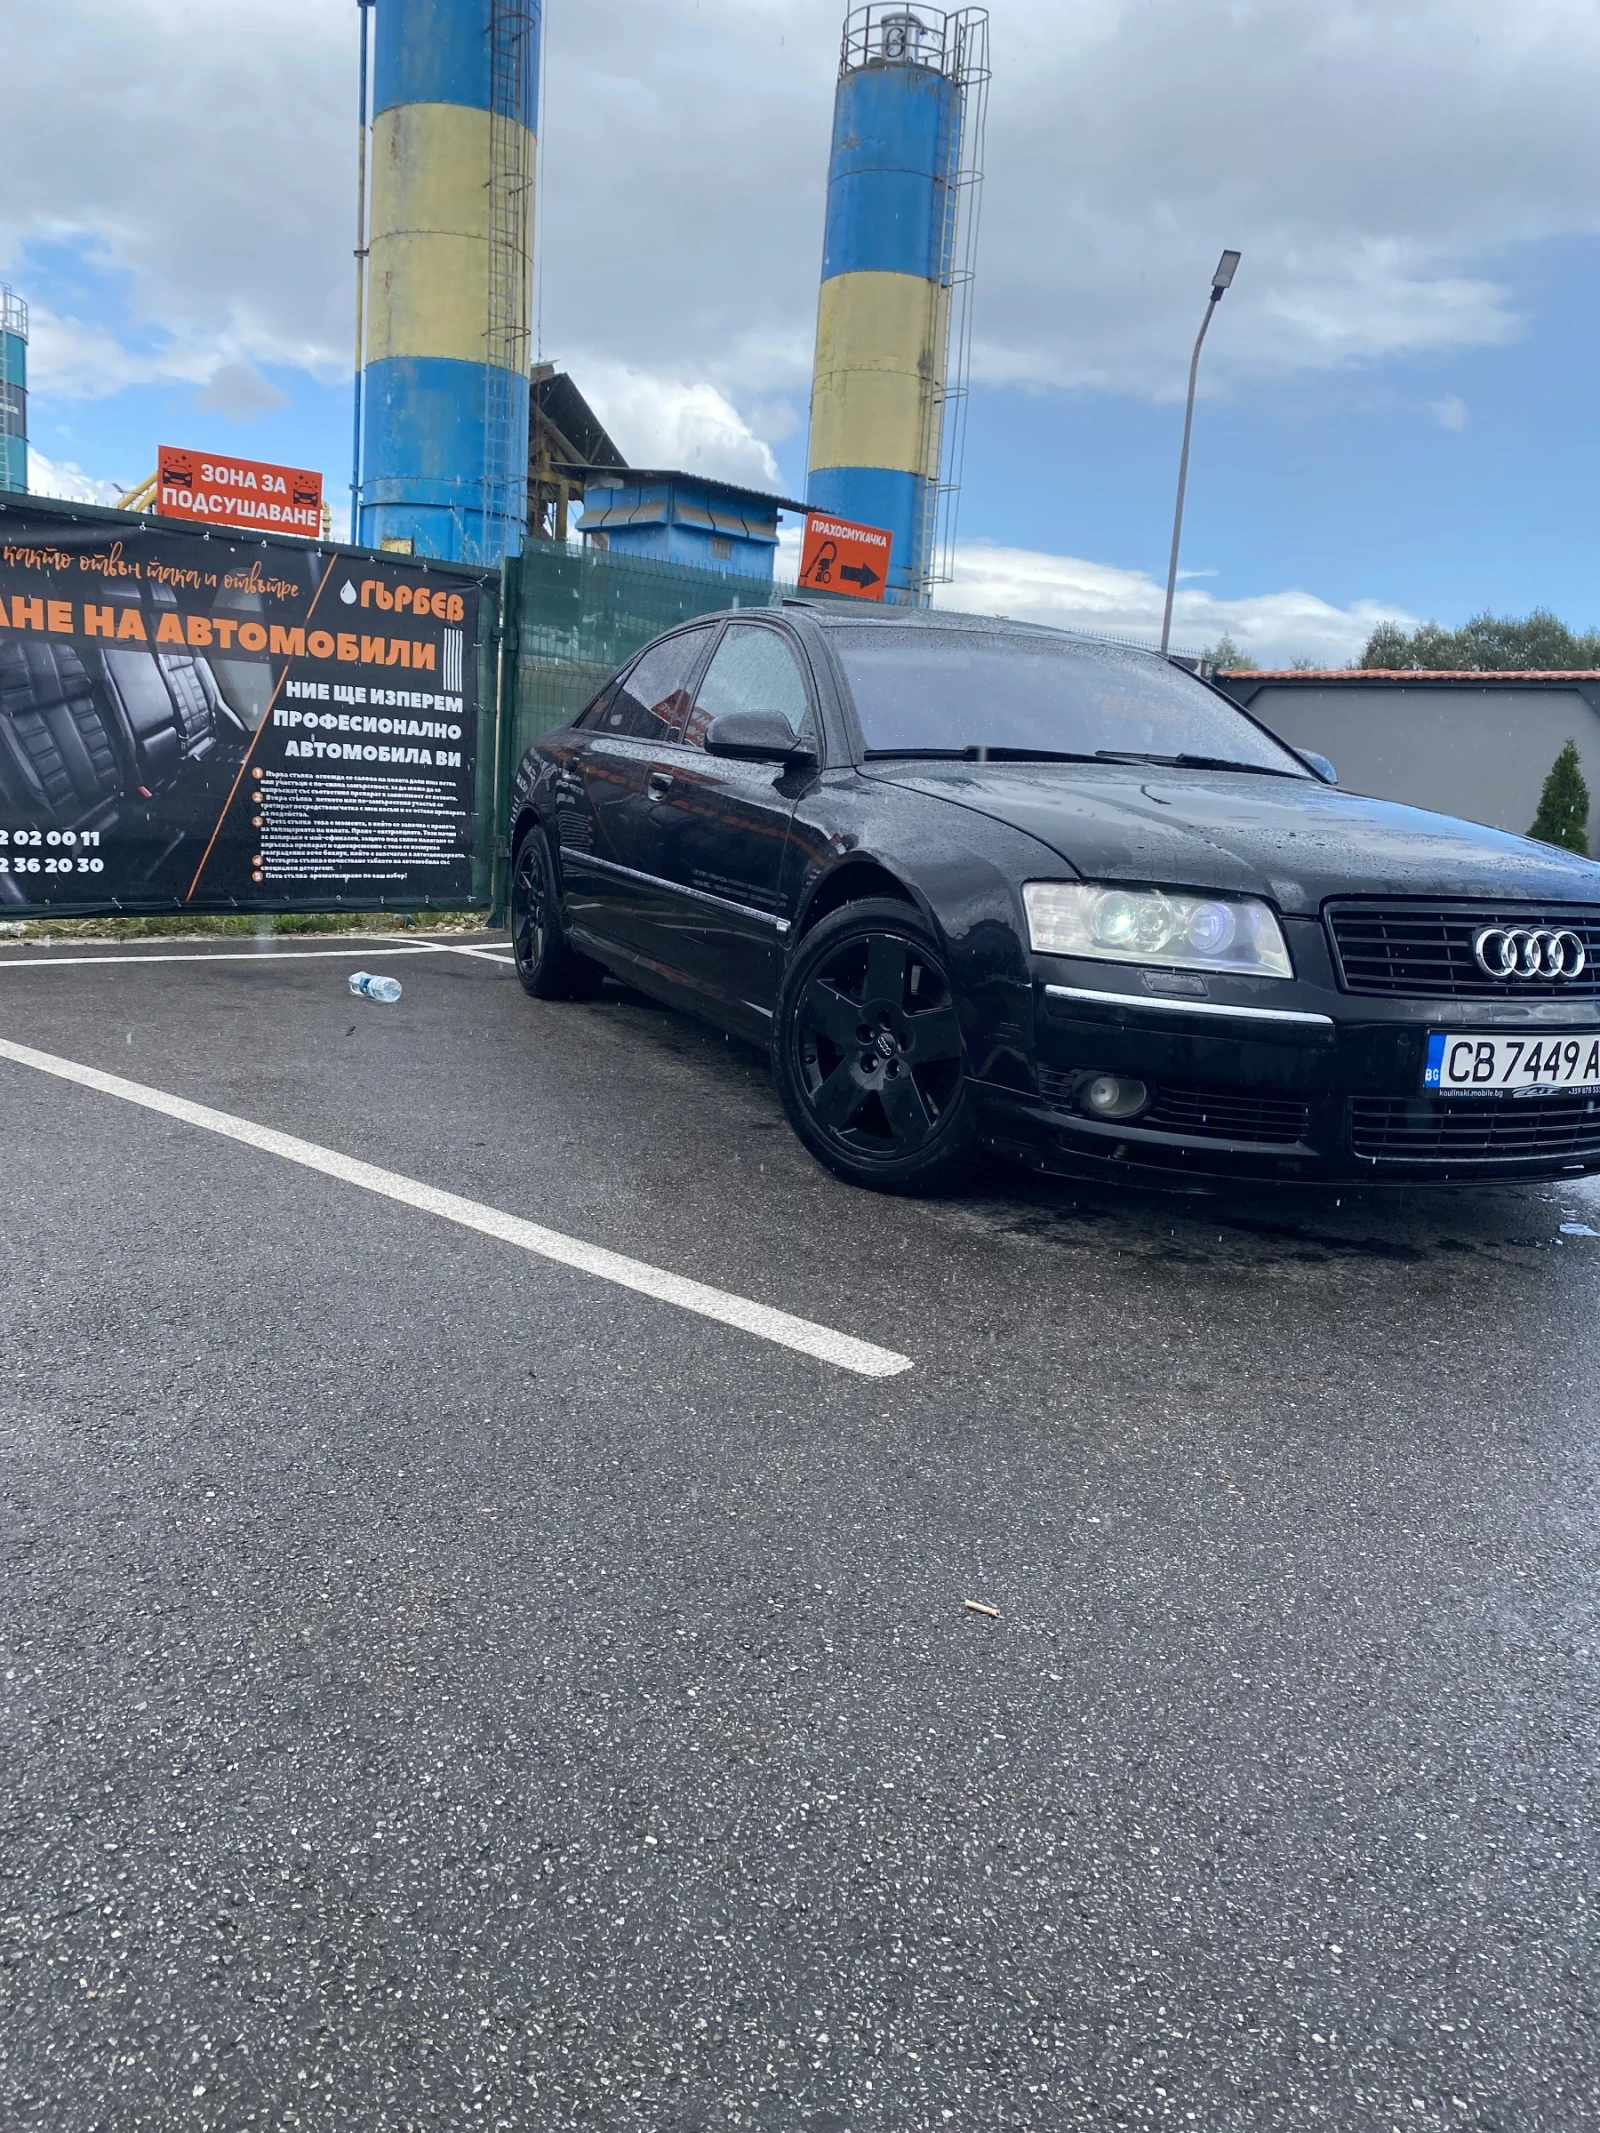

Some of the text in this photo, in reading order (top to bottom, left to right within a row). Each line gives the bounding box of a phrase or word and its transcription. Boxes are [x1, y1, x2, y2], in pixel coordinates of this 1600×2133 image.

[200, 463, 287, 494] ЗОНА ЗА
[162, 487, 318, 527] ПОДСУШАВАНЕ
[811, 519, 887, 548] ПРАХОСМУКАЧКА
[360, 579, 465, 622] ГЪРБЕВ
[83, 603, 148, 641] НА
[155, 612, 437, 671] АВТОМОБИЛИ
[286, 680, 463, 713] НИЕ ЩЕ ИЗПЕРЕМ
[273, 709, 462, 740] ПРОФЕСИОНАЛНО
[284, 740, 462, 767] АВТОМОБИЛА ВИ
[0, 829, 100, 846] 2 02 00 11
[0, 857, 104, 873] 2 36 20 30
[1425, 1068, 1439, 1082] BG
[1501, 1040, 1581, 1083] 7449
